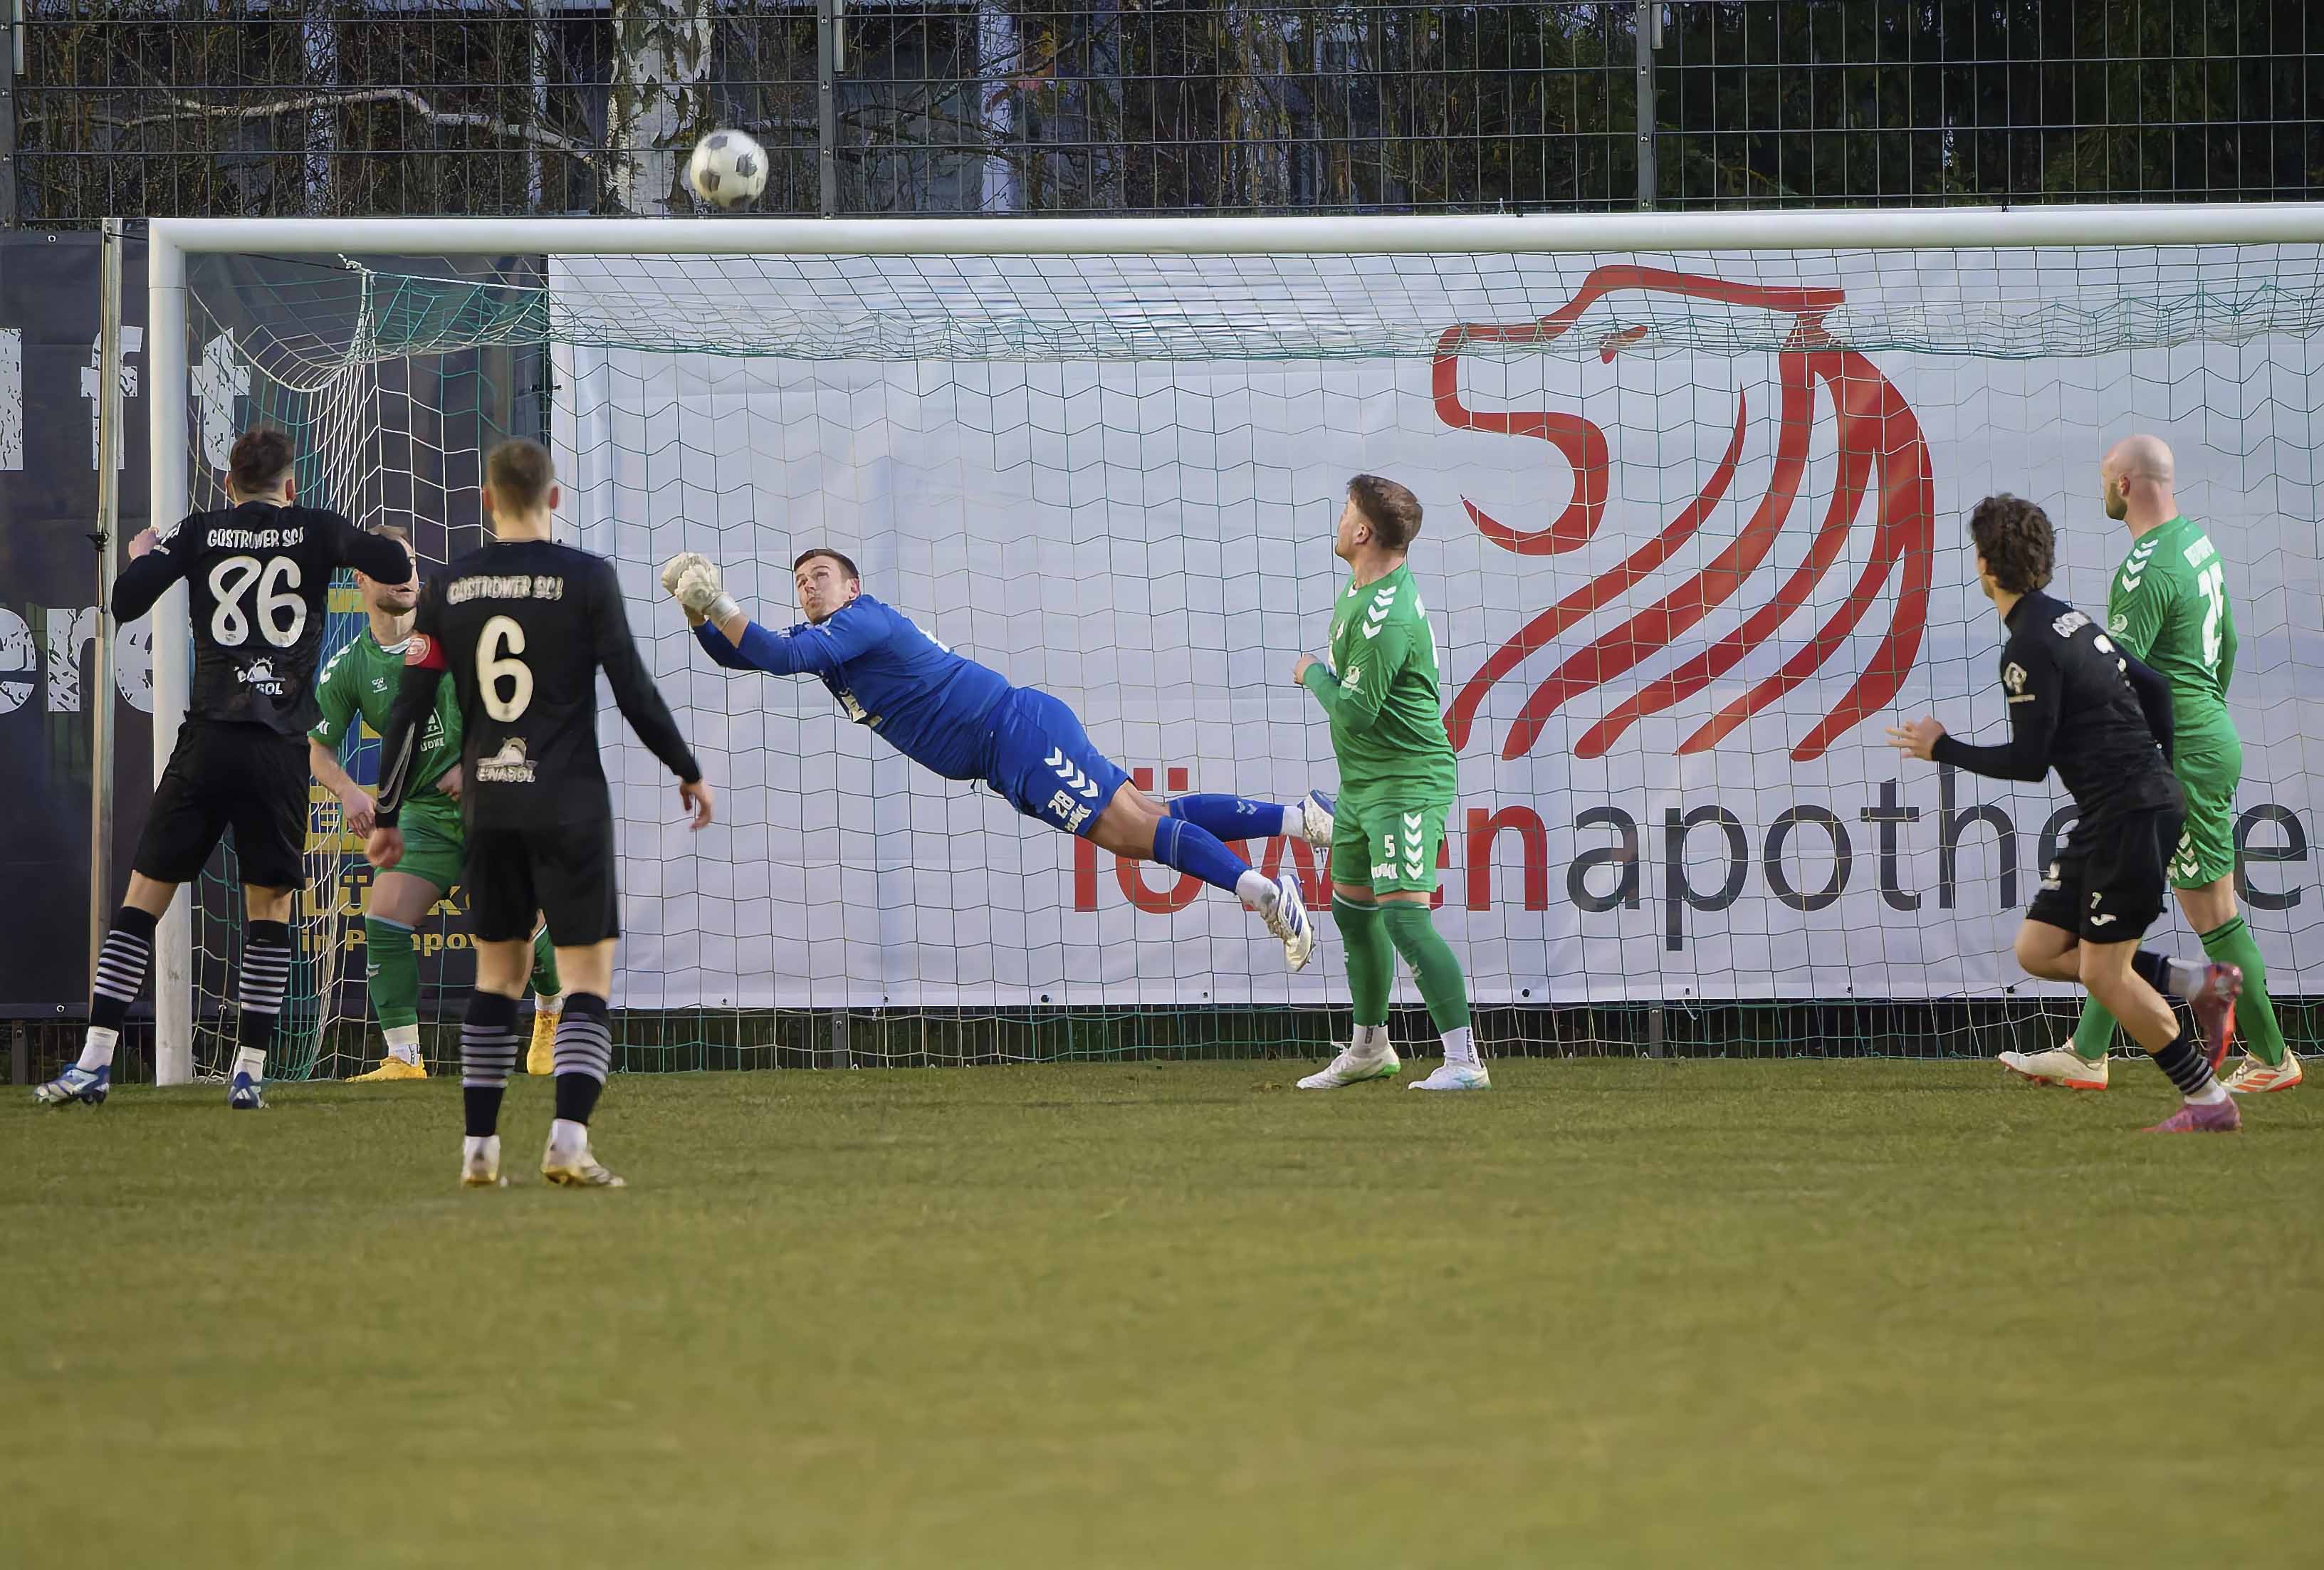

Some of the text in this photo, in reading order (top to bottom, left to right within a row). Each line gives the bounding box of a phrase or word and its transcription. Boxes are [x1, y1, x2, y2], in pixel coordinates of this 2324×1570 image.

[209, 555, 308, 648] 86
[475, 614, 534, 723] 6
[1047, 790, 1076, 819] 28
[1384, 834, 1396, 858] 5
[2090, 891, 2103, 909] 7
